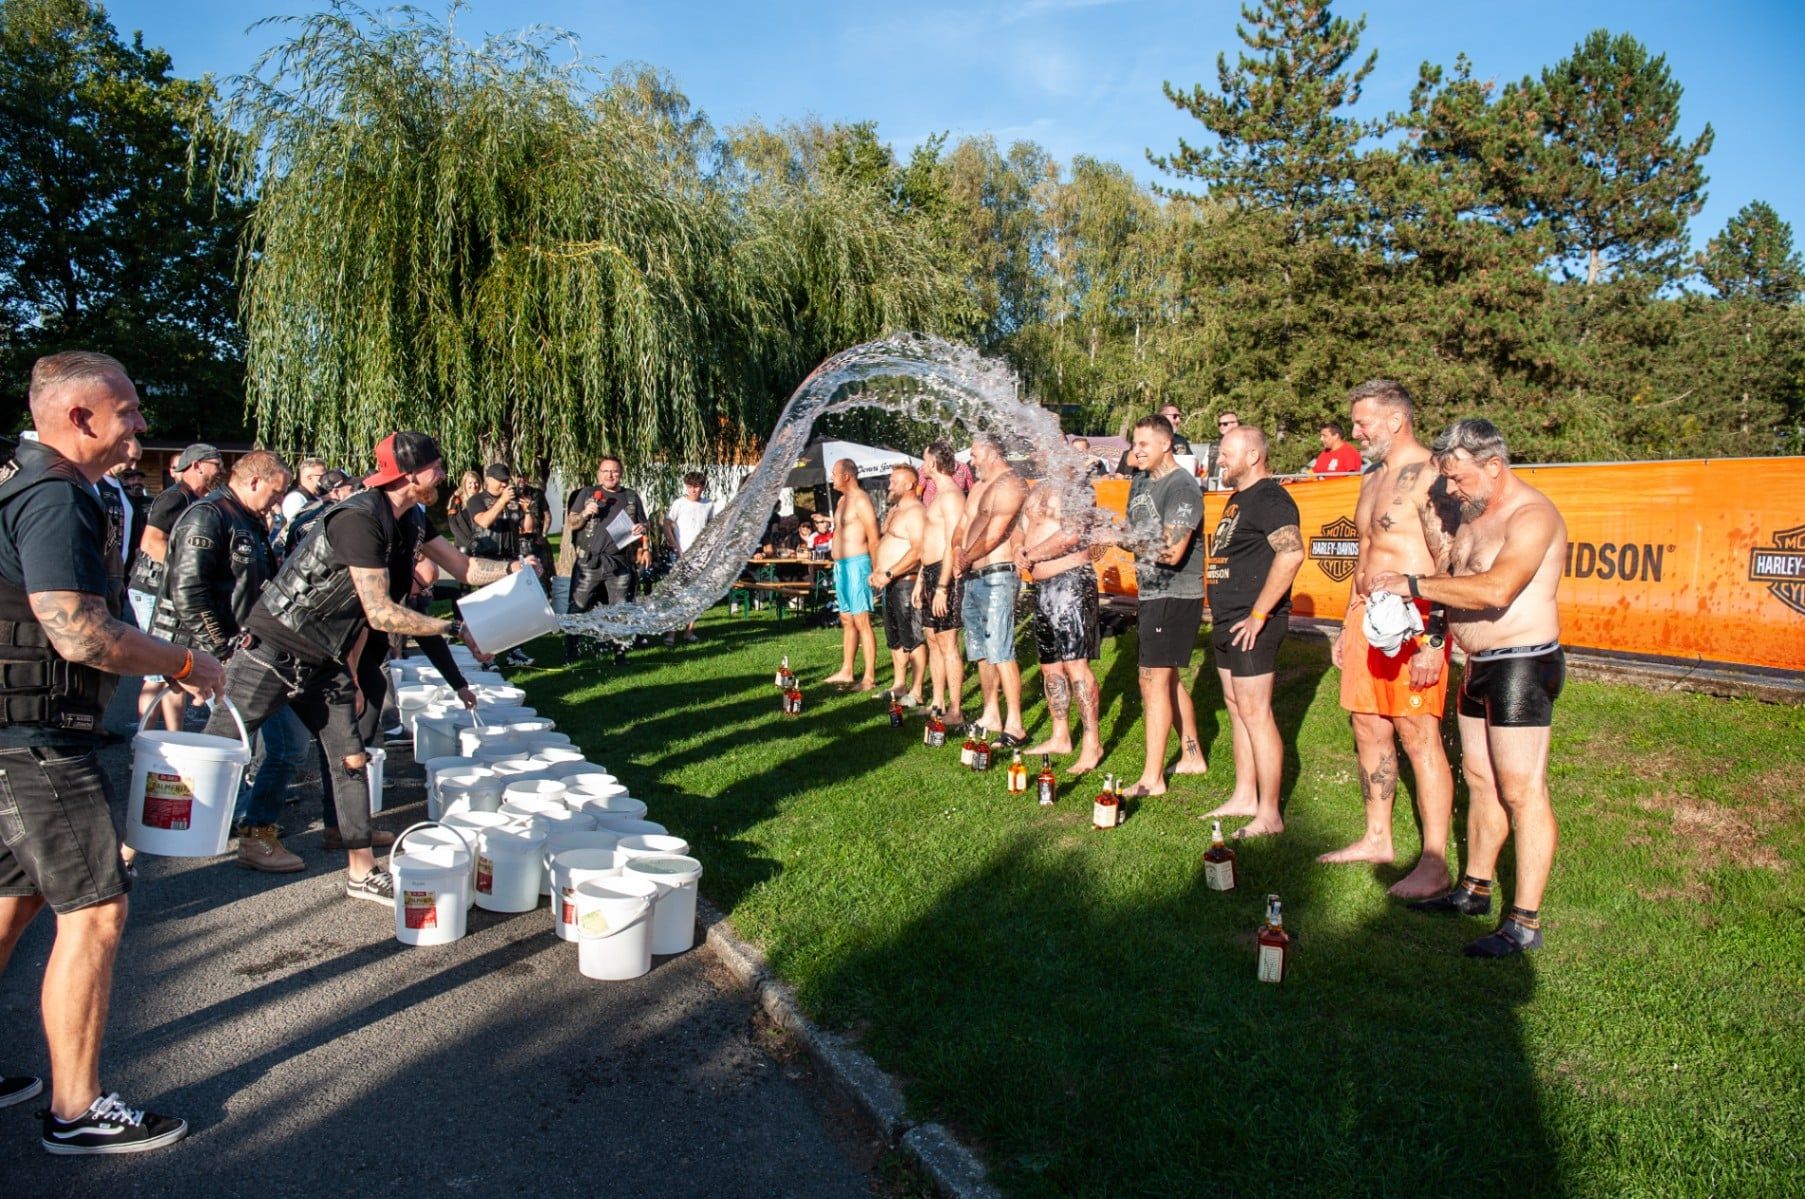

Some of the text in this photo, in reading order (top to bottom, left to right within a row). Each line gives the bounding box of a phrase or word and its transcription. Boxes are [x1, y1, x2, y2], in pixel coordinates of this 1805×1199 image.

[1326, 523, 1357, 537] MOTOR
[1312, 542, 1359, 555] HARLEY-DAVIDS
[1785, 533, 1805, 549] MO
[1323, 560, 1354, 577] CYCLES
[1564, 542, 1664, 582] IDSON
[1756, 555, 1805, 575] HARLEY-
